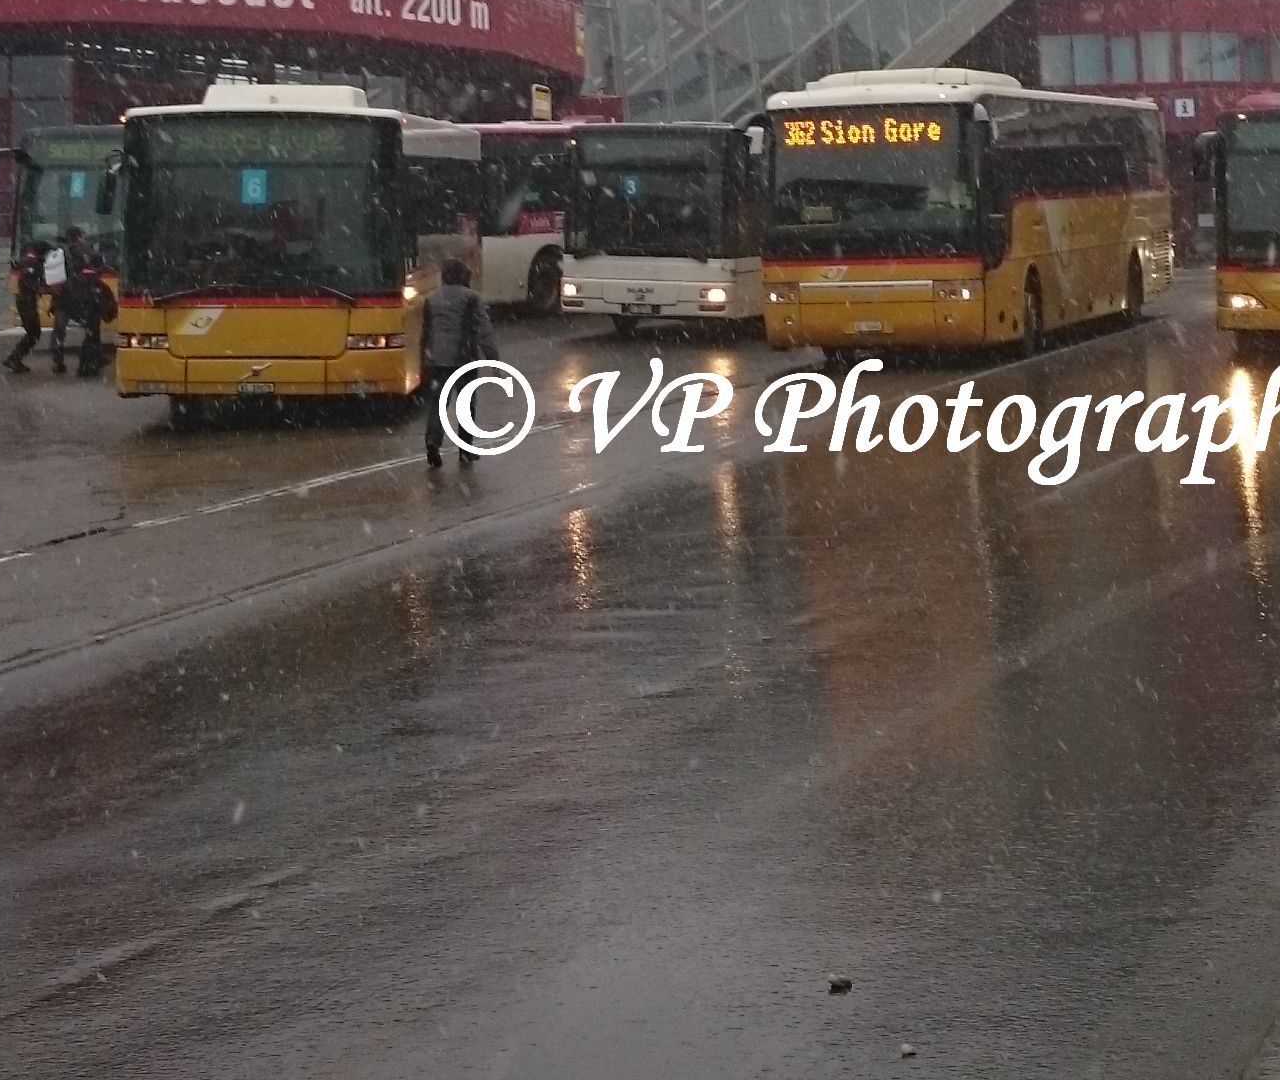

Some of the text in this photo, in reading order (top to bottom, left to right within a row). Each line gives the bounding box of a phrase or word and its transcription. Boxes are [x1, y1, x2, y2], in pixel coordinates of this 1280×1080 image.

[469, 0, 491, 31] m
[784, 120, 816, 146] 362
[820, 120, 875, 144] Sion
[249, 178, 261, 198] 6
[626, 179, 636, 194] 3
